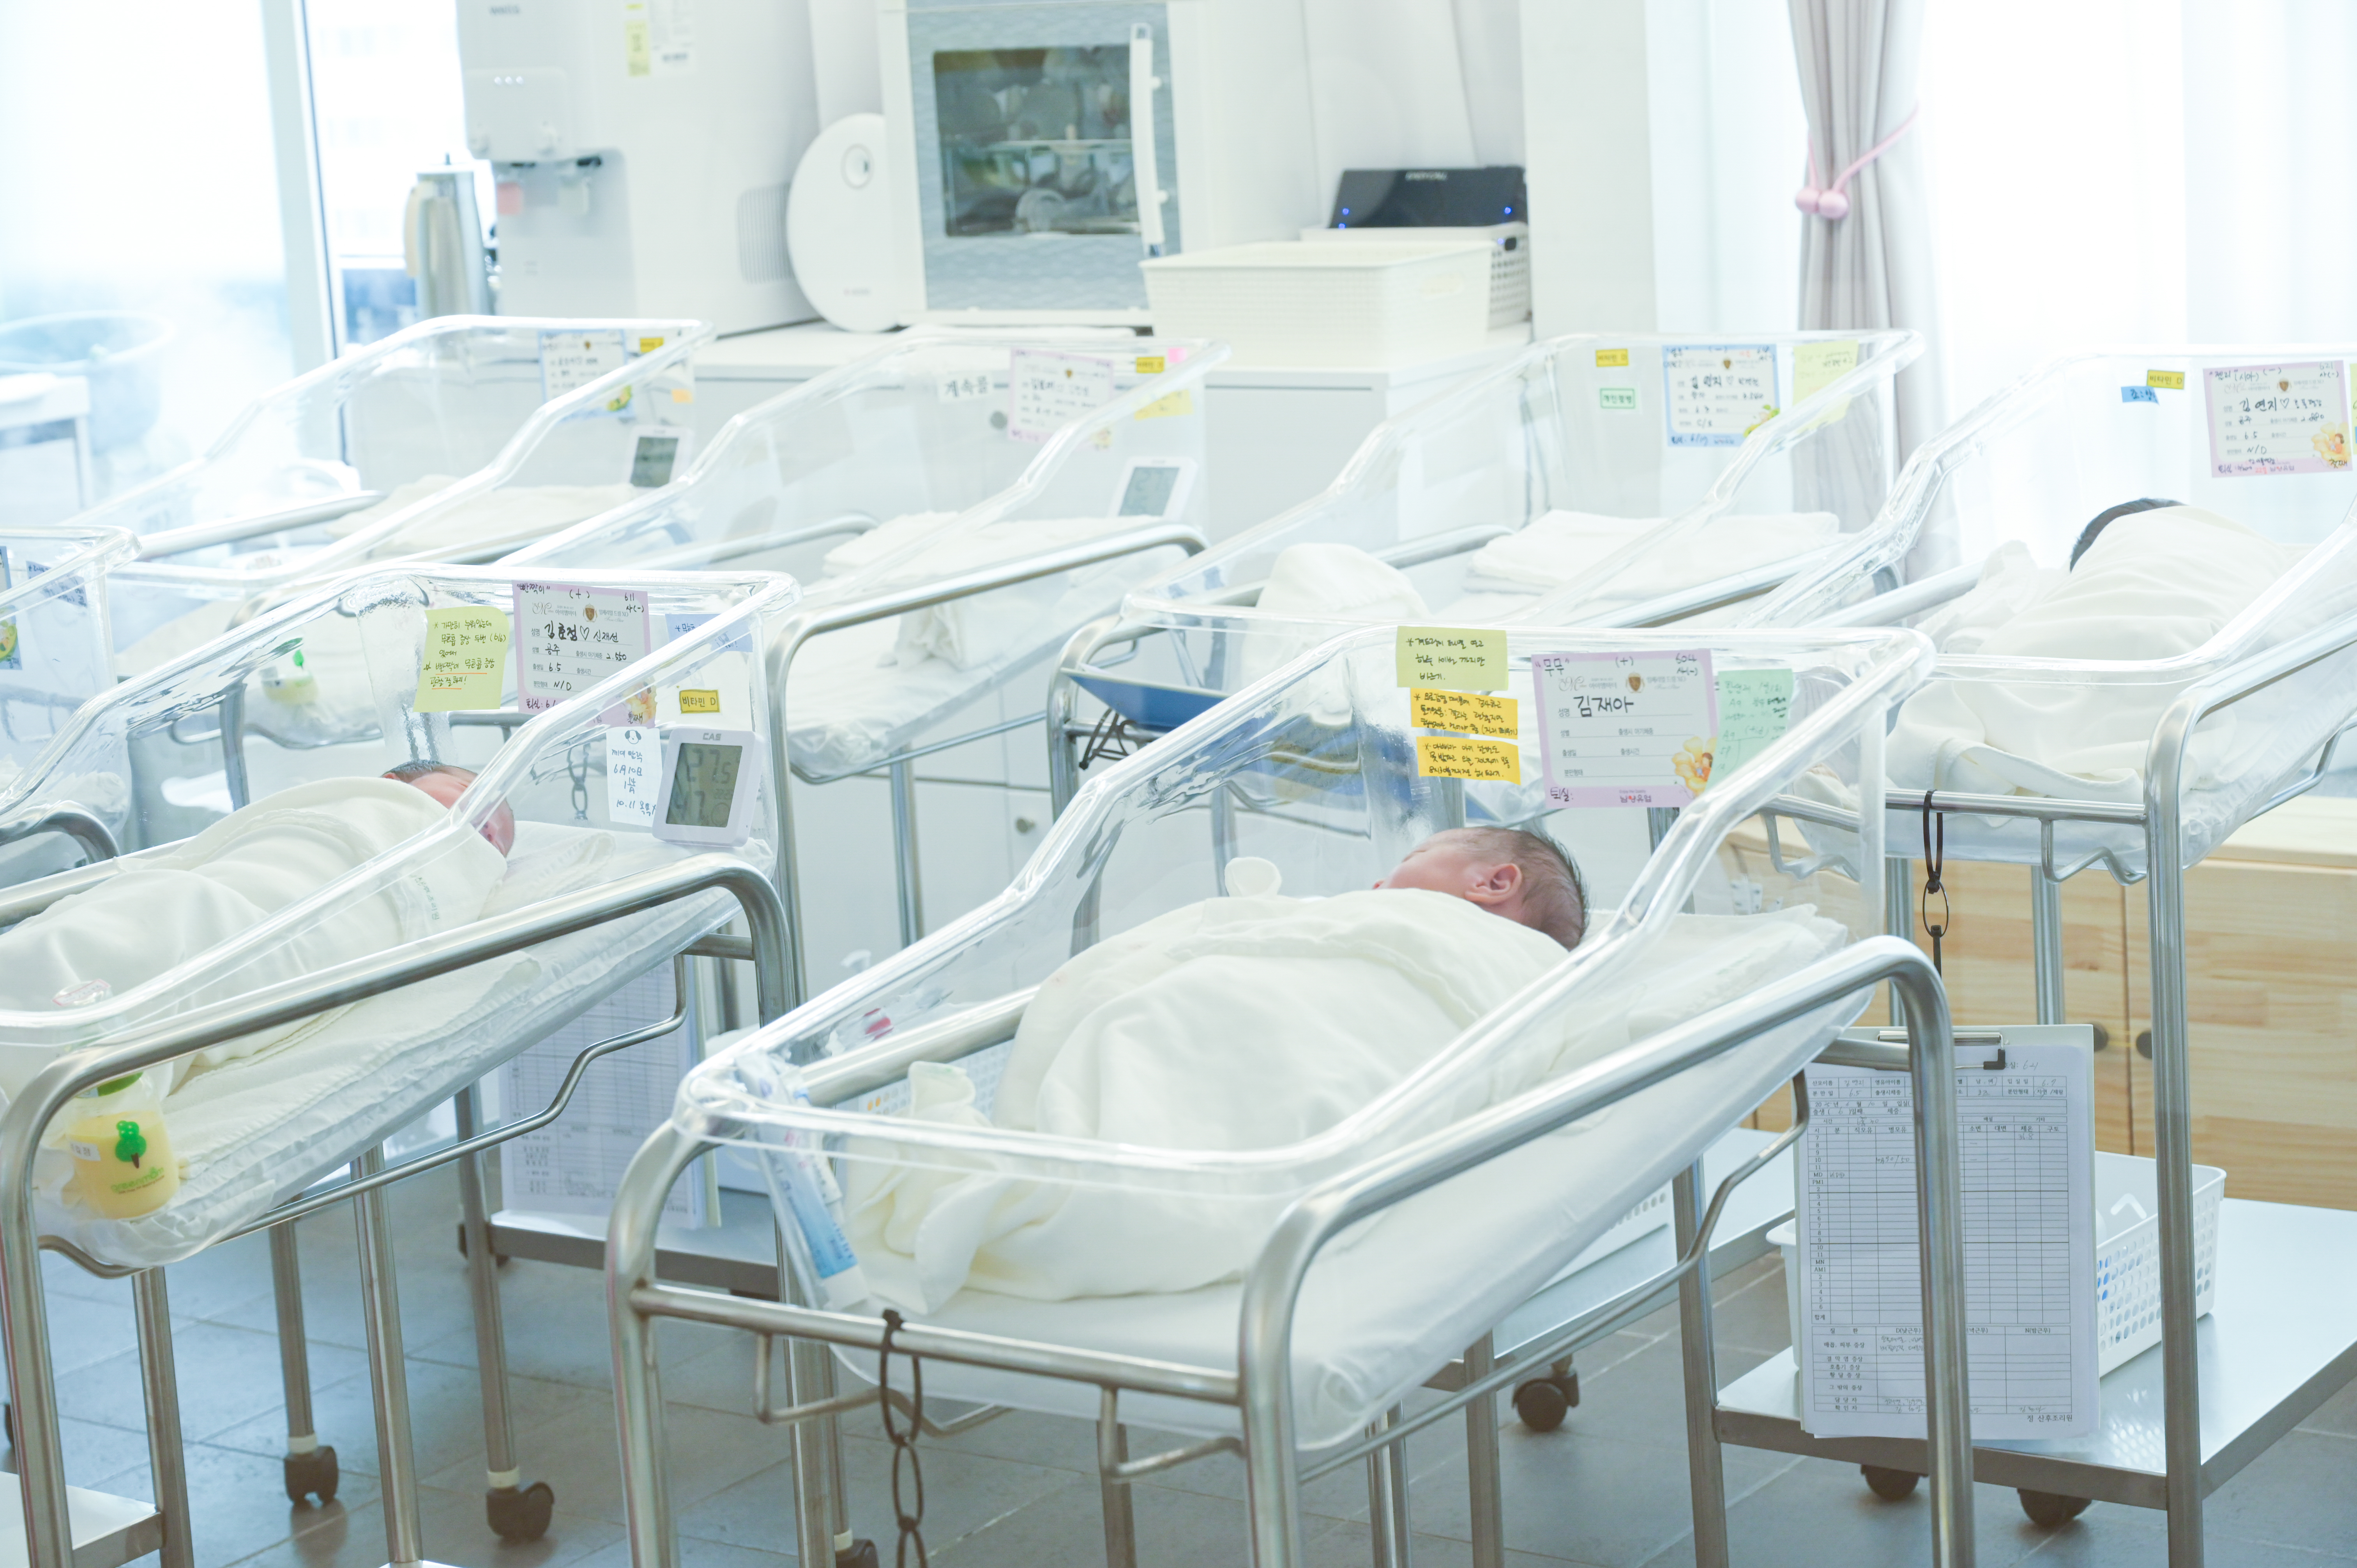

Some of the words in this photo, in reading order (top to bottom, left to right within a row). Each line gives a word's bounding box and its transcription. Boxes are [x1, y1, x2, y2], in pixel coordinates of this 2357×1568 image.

[2239, 397, 2250, 412] 김
[2255, 397, 2277, 411] 연지
[441, 621, 460, 630] 가만히
[531, 628, 540, 636] 성명
[442, 634, 456, 646] 무호흡
[460, 634, 471, 645] 증상
[474, 634, 486, 643] 두번
[545, 643, 560, 656] 공주
[606, 652, 627, 661] 2.550
[465, 658, 482, 669] 무호흡
[484, 658, 495, 668] 증상
[549, 662, 562, 671] 6.5
[553, 680, 572, 691] N/D
[682, 696, 705, 707] 비타민
[710, 697, 716, 706] D
[1559, 708, 1570, 717] 성명
[1573, 695, 1634, 717] 김재아
[703, 733, 721, 741] CAS
